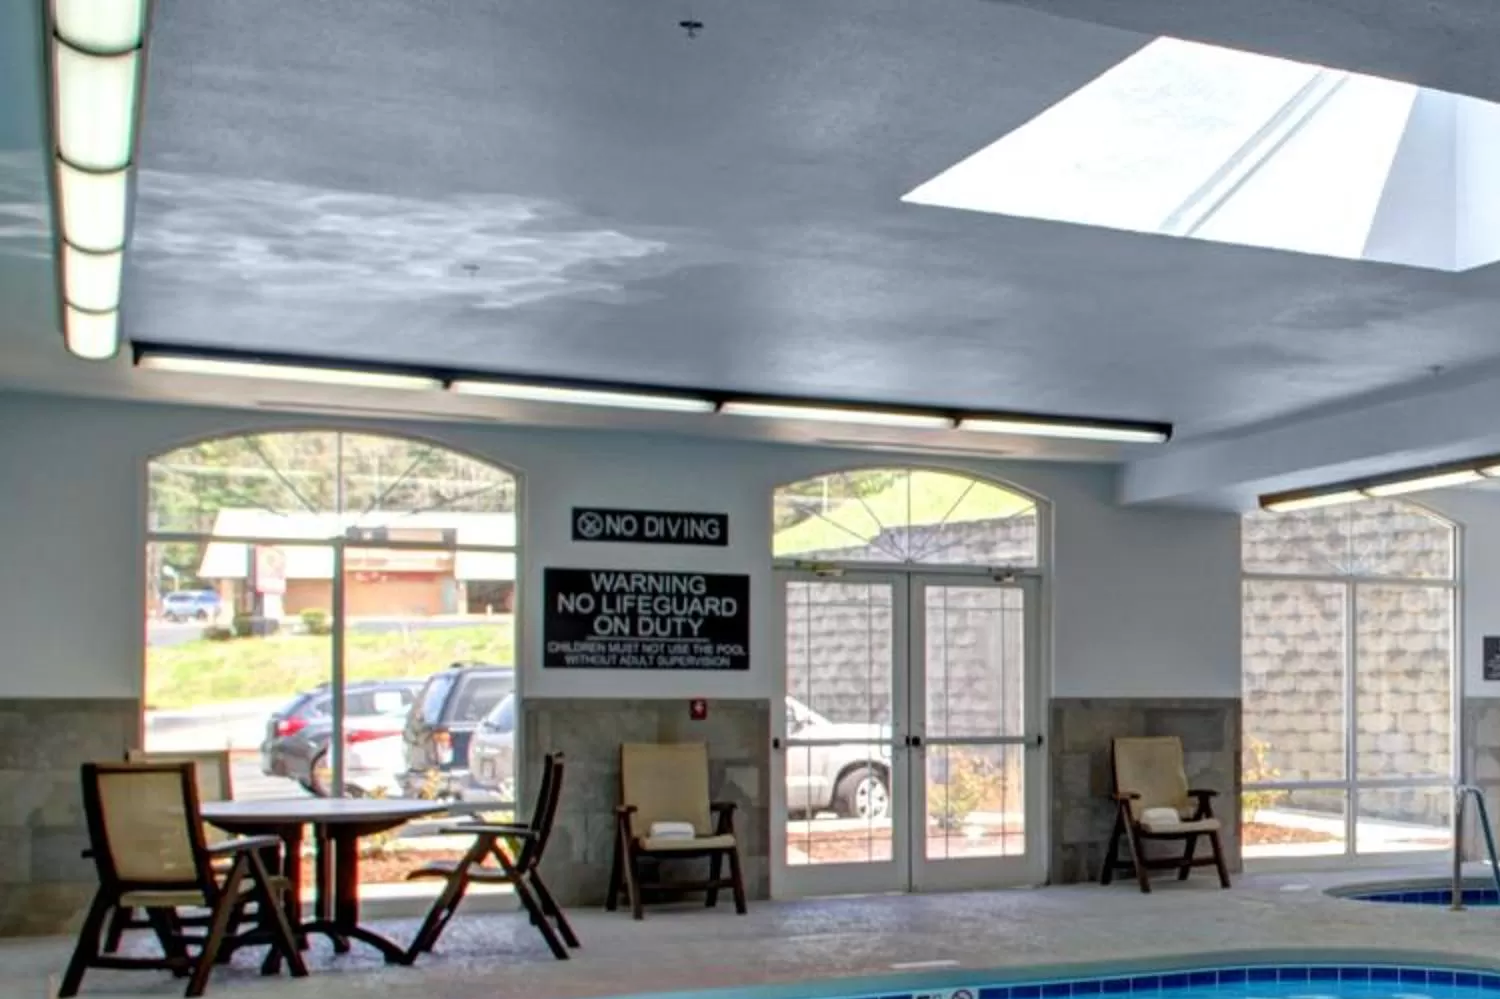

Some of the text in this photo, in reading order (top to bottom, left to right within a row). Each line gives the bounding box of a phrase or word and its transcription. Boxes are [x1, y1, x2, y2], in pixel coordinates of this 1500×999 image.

[605, 514, 721, 540] NO DIVING
[591, 572, 707, 595] WARNING
[557, 592, 738, 617] NO LIFEGUARD
[593, 615, 704, 637] ON DUTY
[716, 644, 746, 656] POOL
